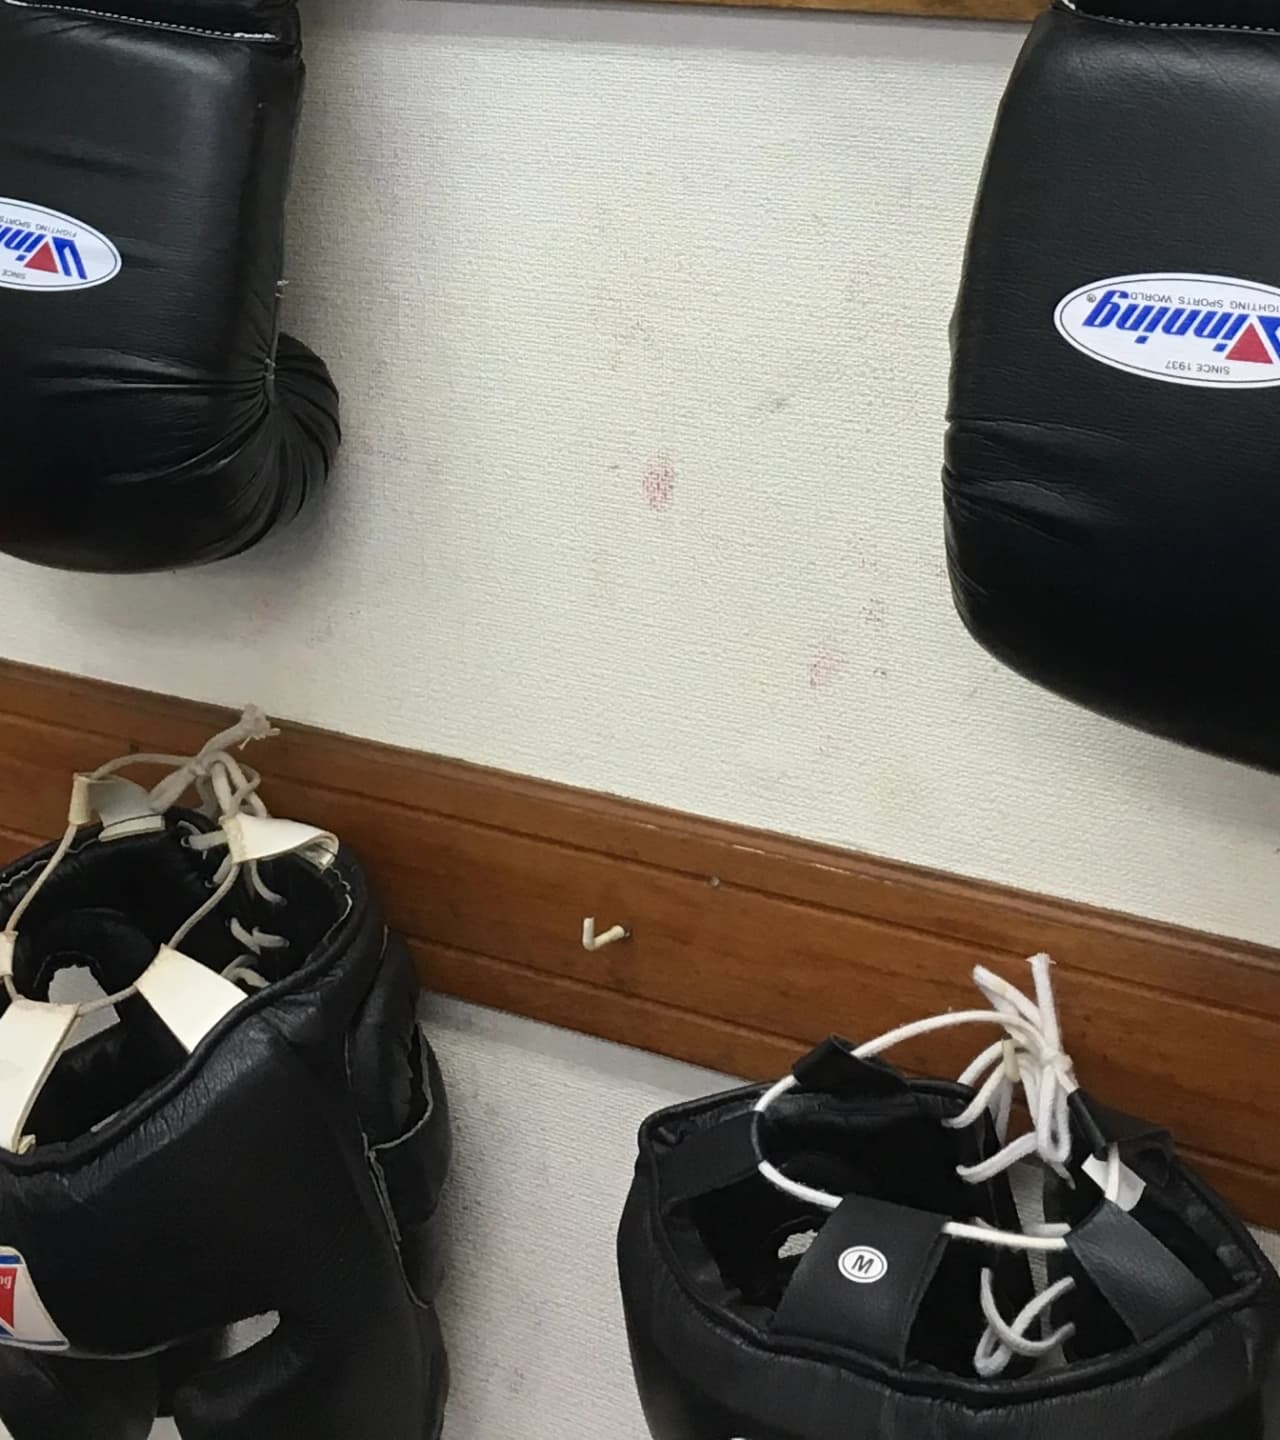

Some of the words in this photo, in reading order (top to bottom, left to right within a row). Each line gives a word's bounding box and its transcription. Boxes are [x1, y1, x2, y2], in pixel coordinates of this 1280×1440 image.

[35, 222, 78, 238] FIGHTING
[1, 268, 26, 280] SINCE
[1130, 291, 1173, 304] WORLD
[1178, 296, 1224, 309] SPORTS
[1165, 360, 1192, 372] 1937
[1195, 363, 1230, 376] SINCE
[851, 1254, 874, 1275] M
